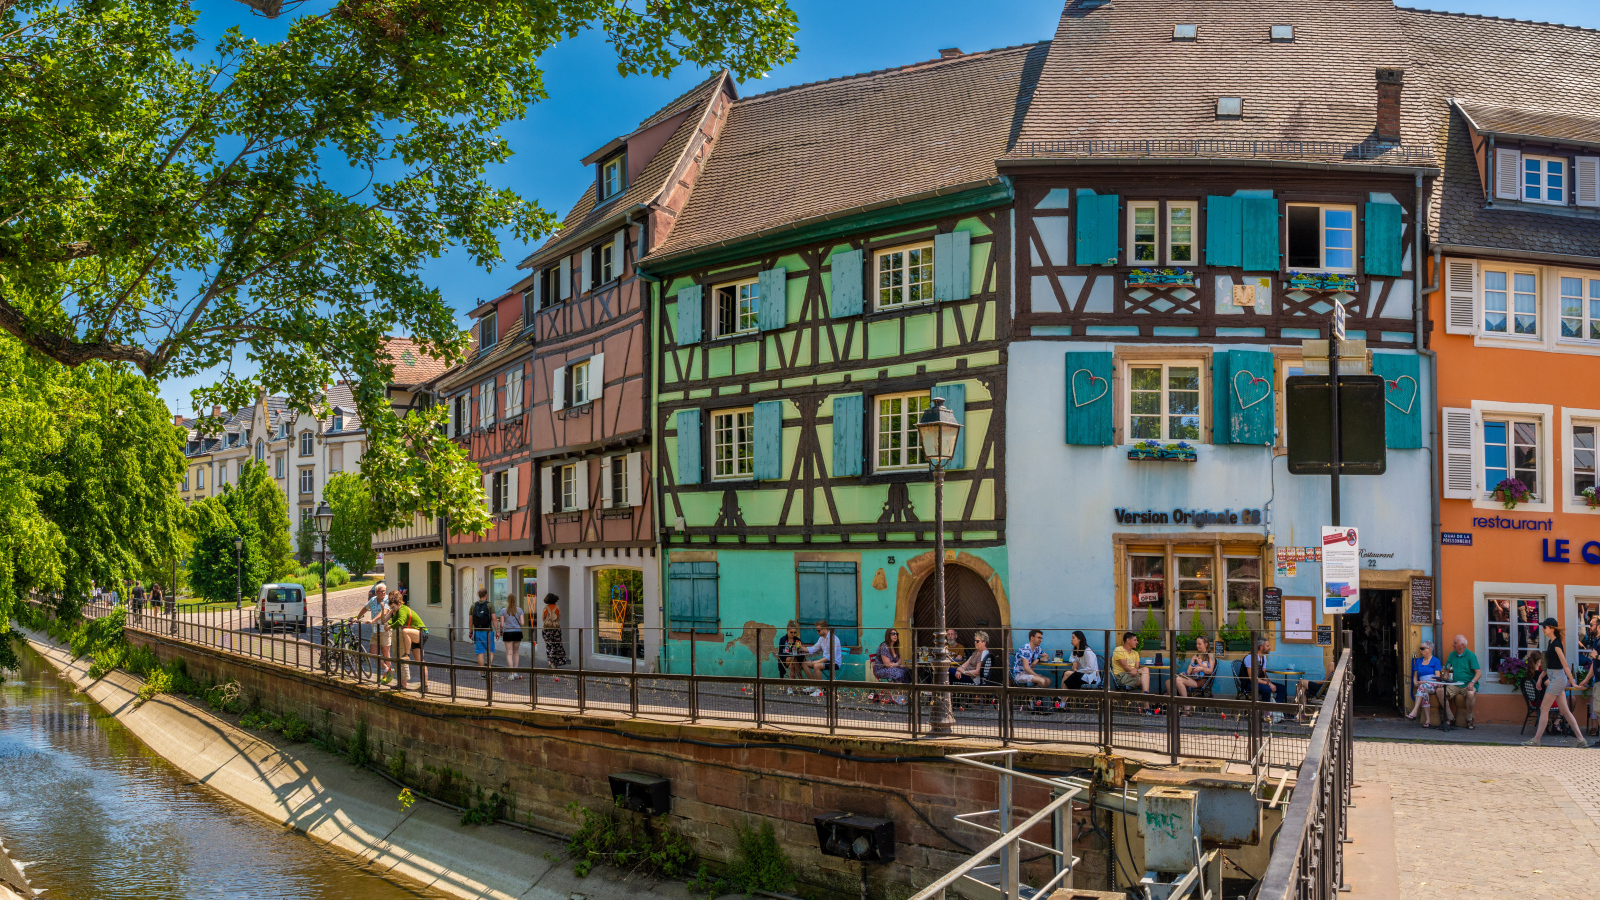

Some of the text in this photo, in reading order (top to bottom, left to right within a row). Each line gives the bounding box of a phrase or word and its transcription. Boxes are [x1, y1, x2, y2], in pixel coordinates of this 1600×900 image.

[1114, 508, 1261, 528] Version Originale 68
[1473, 515, 1553, 531] restaurant
[1358, 548, 1394, 559] Restaurant
[1542, 538, 1570, 563] LE
[887, 556, 896, 564] 23
[1368, 559, 1377, 567] 22
